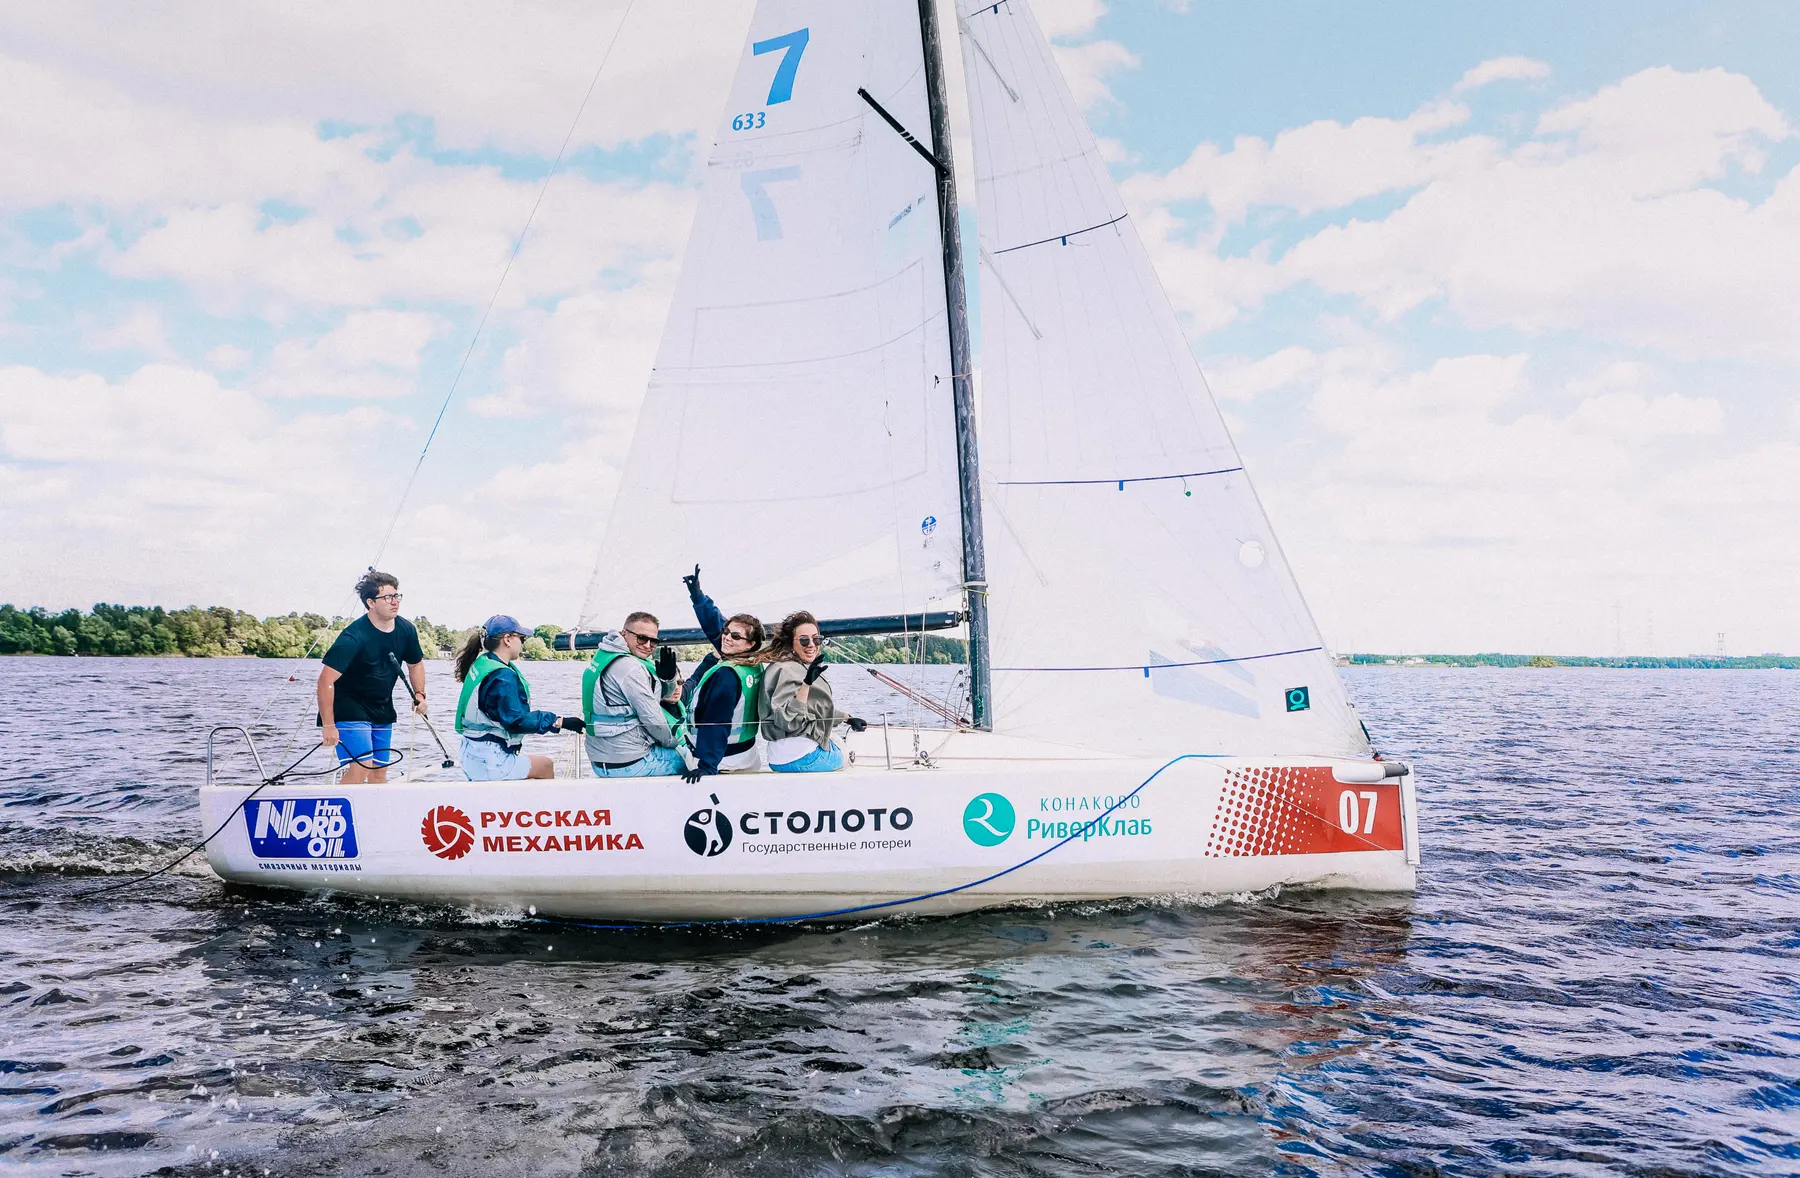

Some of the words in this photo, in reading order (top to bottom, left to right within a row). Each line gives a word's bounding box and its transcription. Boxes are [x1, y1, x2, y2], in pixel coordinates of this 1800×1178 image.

[753, 27, 810, 106] 7
[731, 111, 767, 132] 633
[1040, 795, 1141, 812] КОНАКОВО
[1339, 790, 1378, 835] 07
[480, 808, 612, 829] РУССКАЯ
[739, 807, 914, 835] СТОЛОТО
[1027, 816, 1152, 842] РиверКлаб
[307, 837, 346, 858] OIL
[482, 833, 645, 853] МЕХАНИКА
[742, 840, 857, 854] Государственные
[859, 838, 912, 851] лотереи
[258, 862, 308, 871] смазочные
[310, 862, 363, 873] материалы
